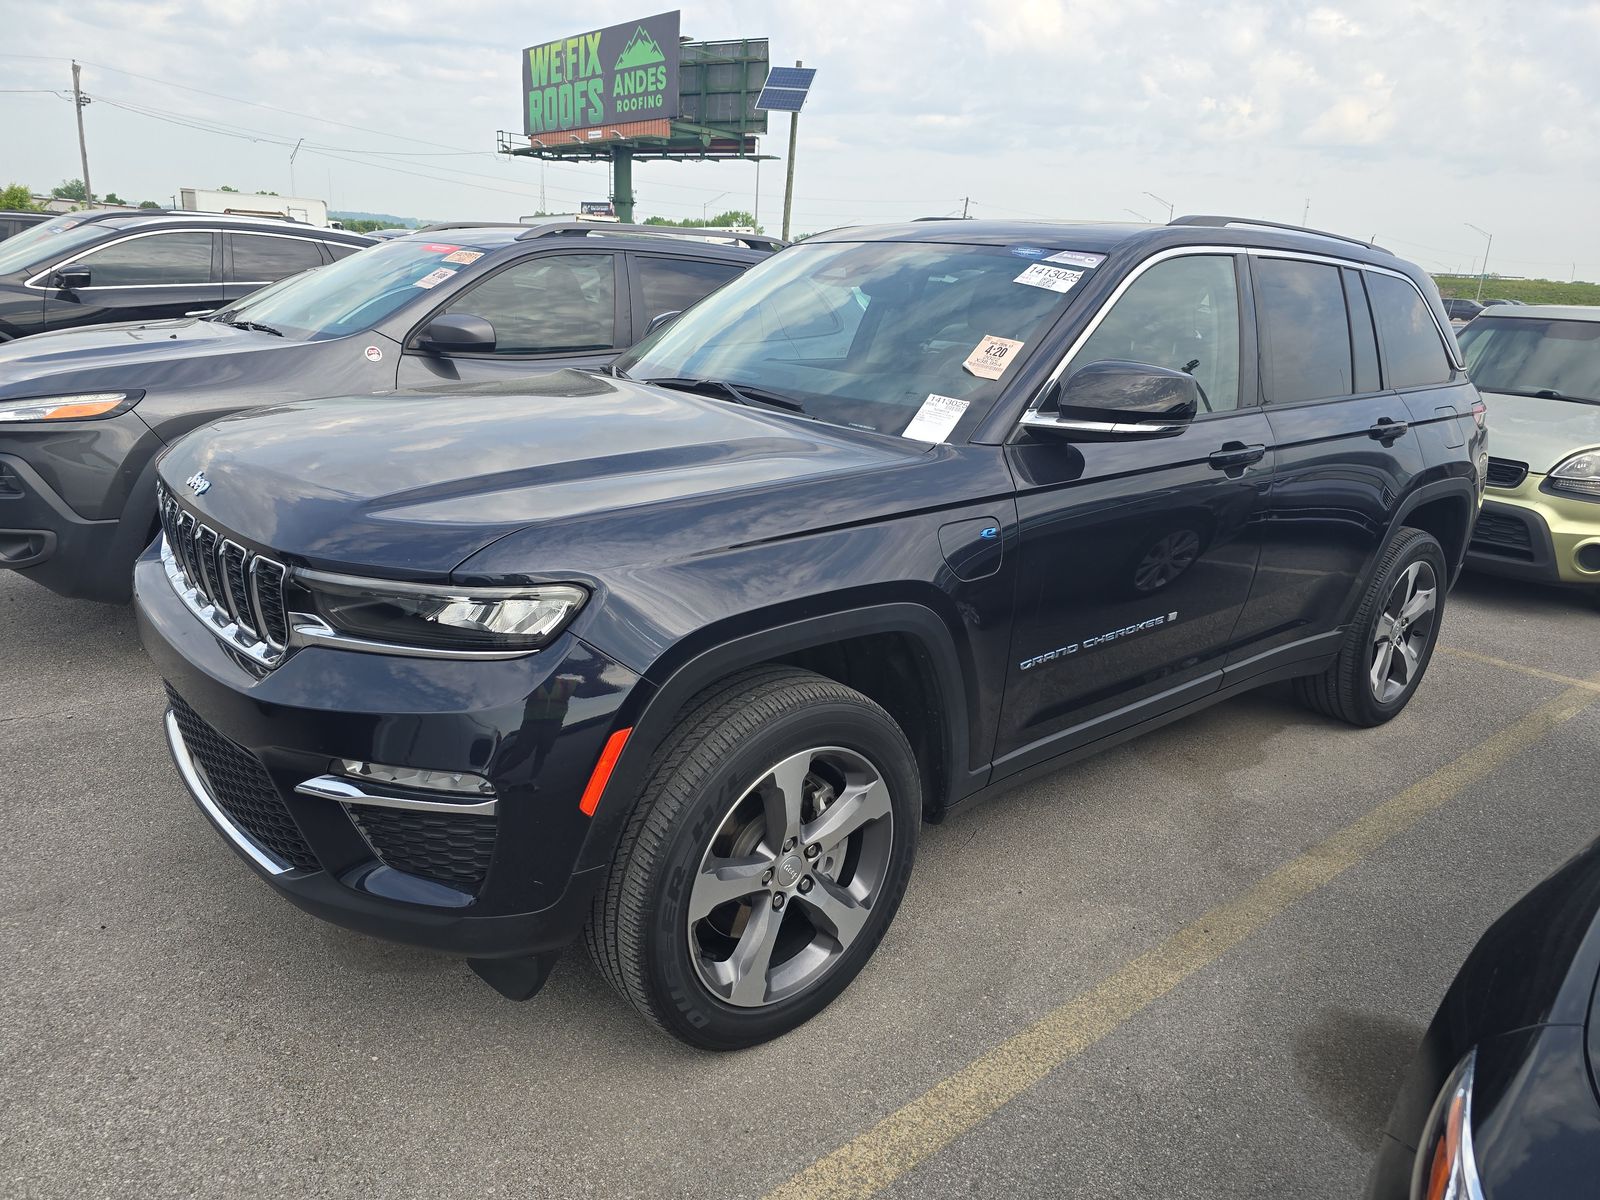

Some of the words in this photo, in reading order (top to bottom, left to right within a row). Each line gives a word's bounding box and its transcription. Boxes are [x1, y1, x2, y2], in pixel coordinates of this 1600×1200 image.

[529, 42, 563, 88] WE
[566, 32, 602, 80] FIX
[613, 66, 667, 97] ANDES
[529, 78, 604, 133] ROOFS
[617, 94, 663, 112] ROOFING
[1028, 266, 1081, 282] 1413025
[985, 345, 1009, 358] 4:20
[186, 470, 212, 496] Jeep
[1020, 644, 1079, 671] GRAND
[1082, 615, 1165, 649] CHEROKEE
